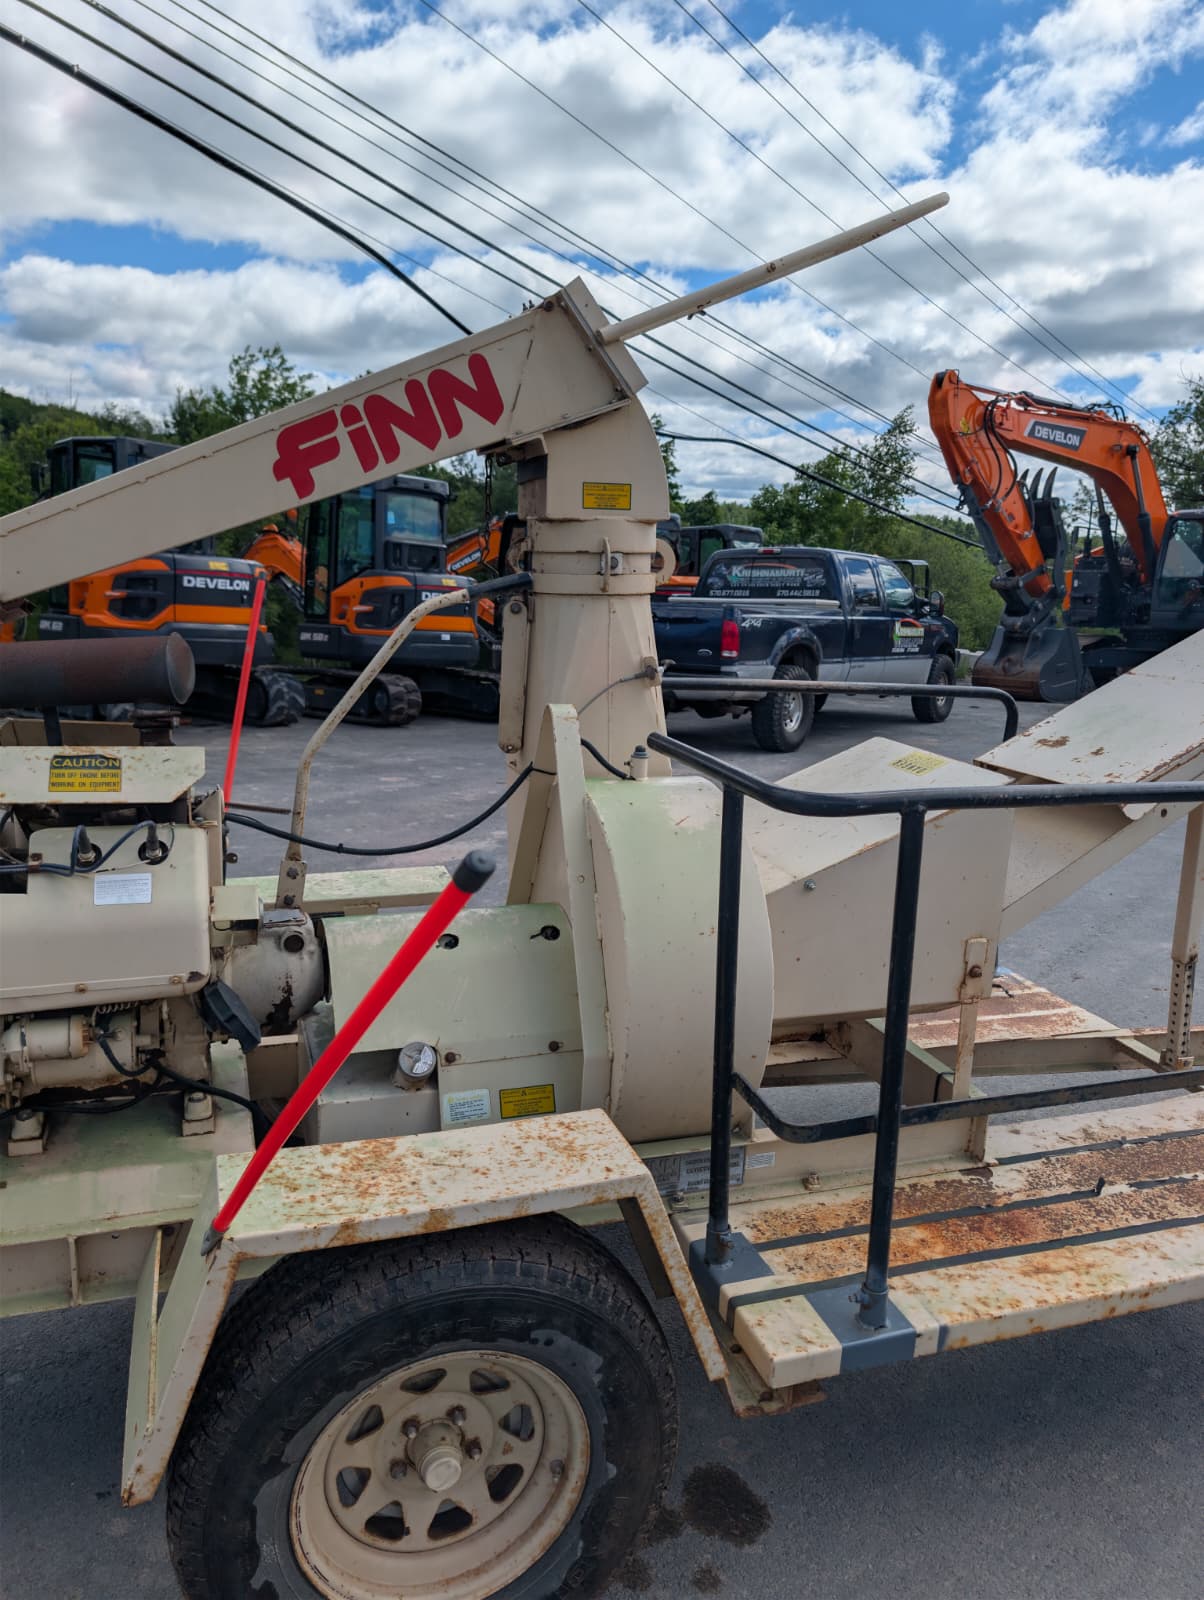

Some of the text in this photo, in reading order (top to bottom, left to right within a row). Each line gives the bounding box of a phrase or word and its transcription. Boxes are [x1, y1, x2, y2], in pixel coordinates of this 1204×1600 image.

[1034, 425, 1080, 446] DEVELON
[182, 576, 250, 591] DEVELON
[52, 758, 120, 767] CAUTION
